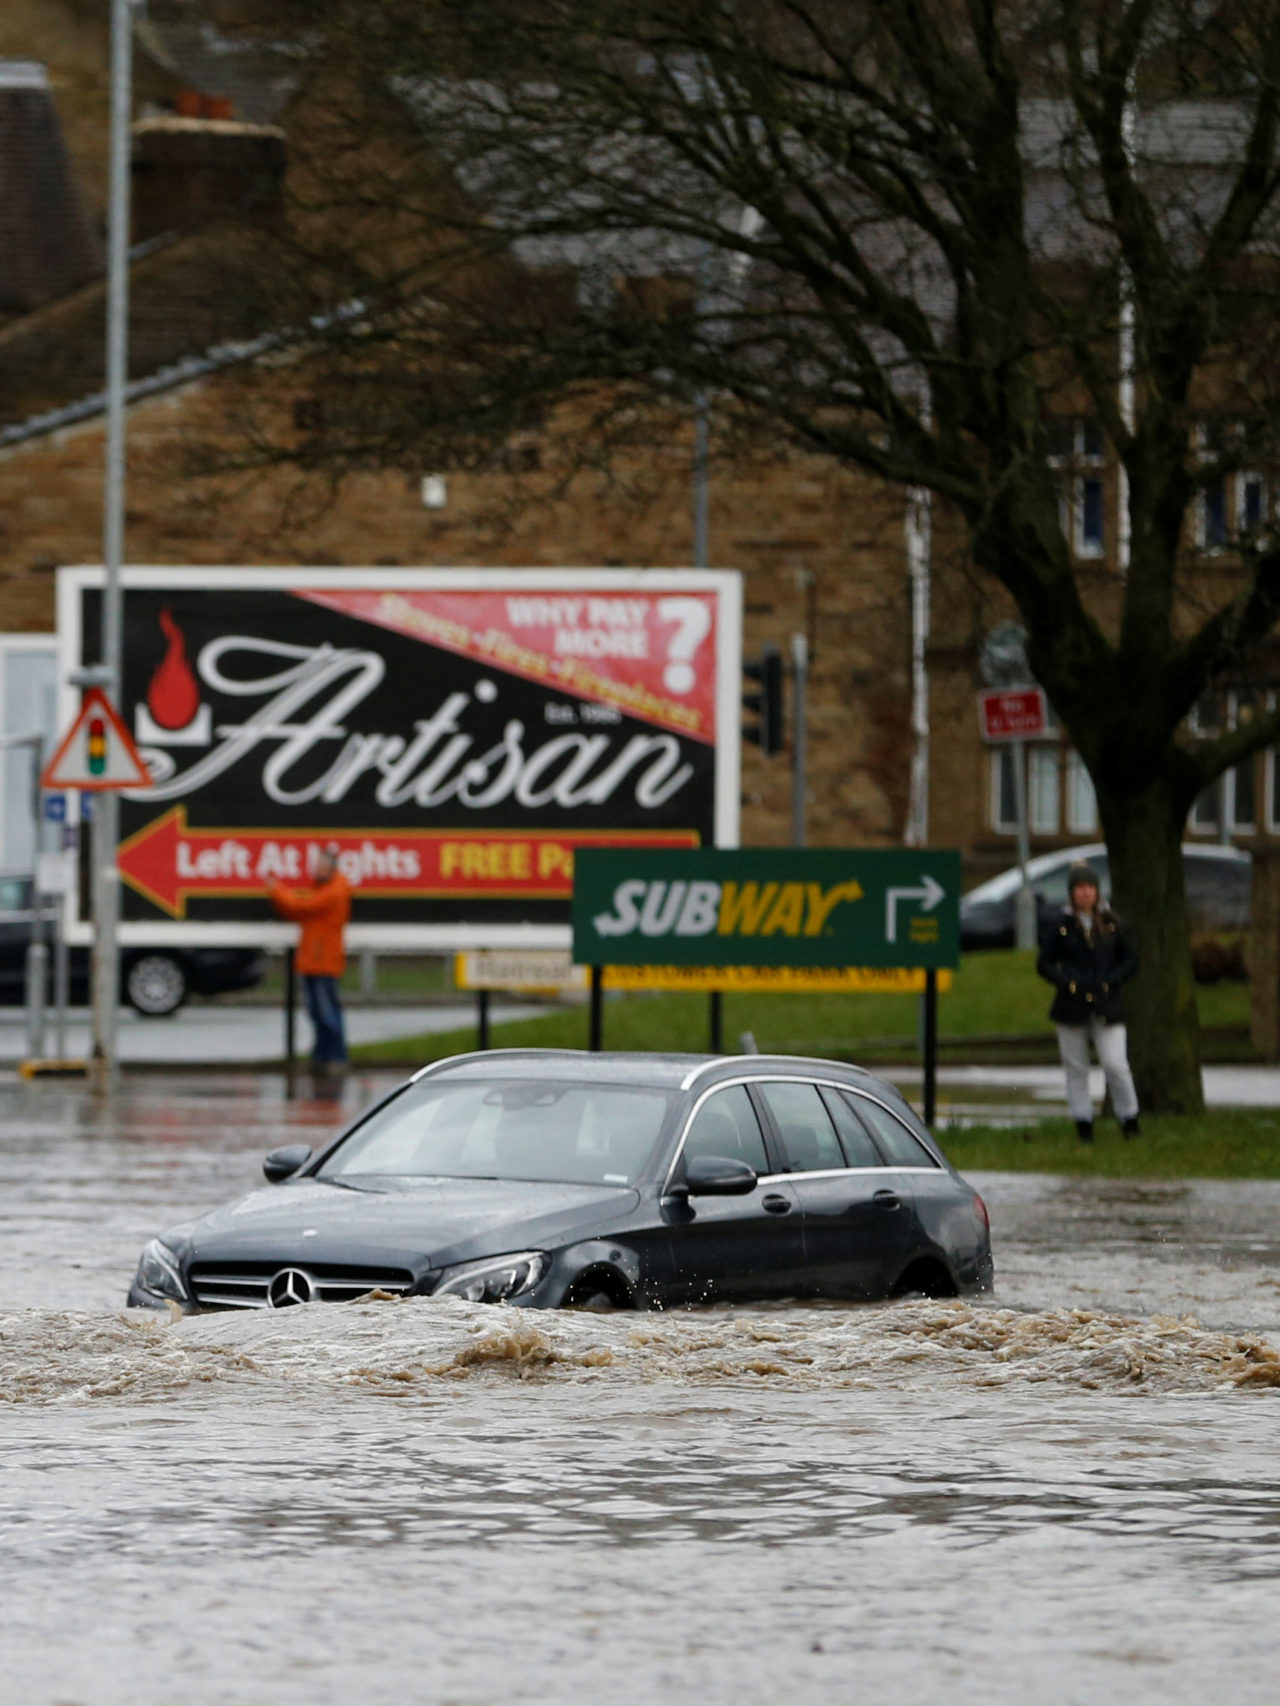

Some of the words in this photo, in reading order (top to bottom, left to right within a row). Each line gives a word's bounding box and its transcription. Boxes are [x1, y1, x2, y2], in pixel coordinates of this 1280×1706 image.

[506, 596, 584, 627] WHY
[588, 596, 650, 627] PAY
[554, 628, 650, 660] MORE
[120, 635, 696, 808] Artisan
[176, 841, 251, 878] Left
[257, 841, 301, 878] At
[439, 842, 532, 879] FREE
[593, 878, 864, 938] SUBWAY
